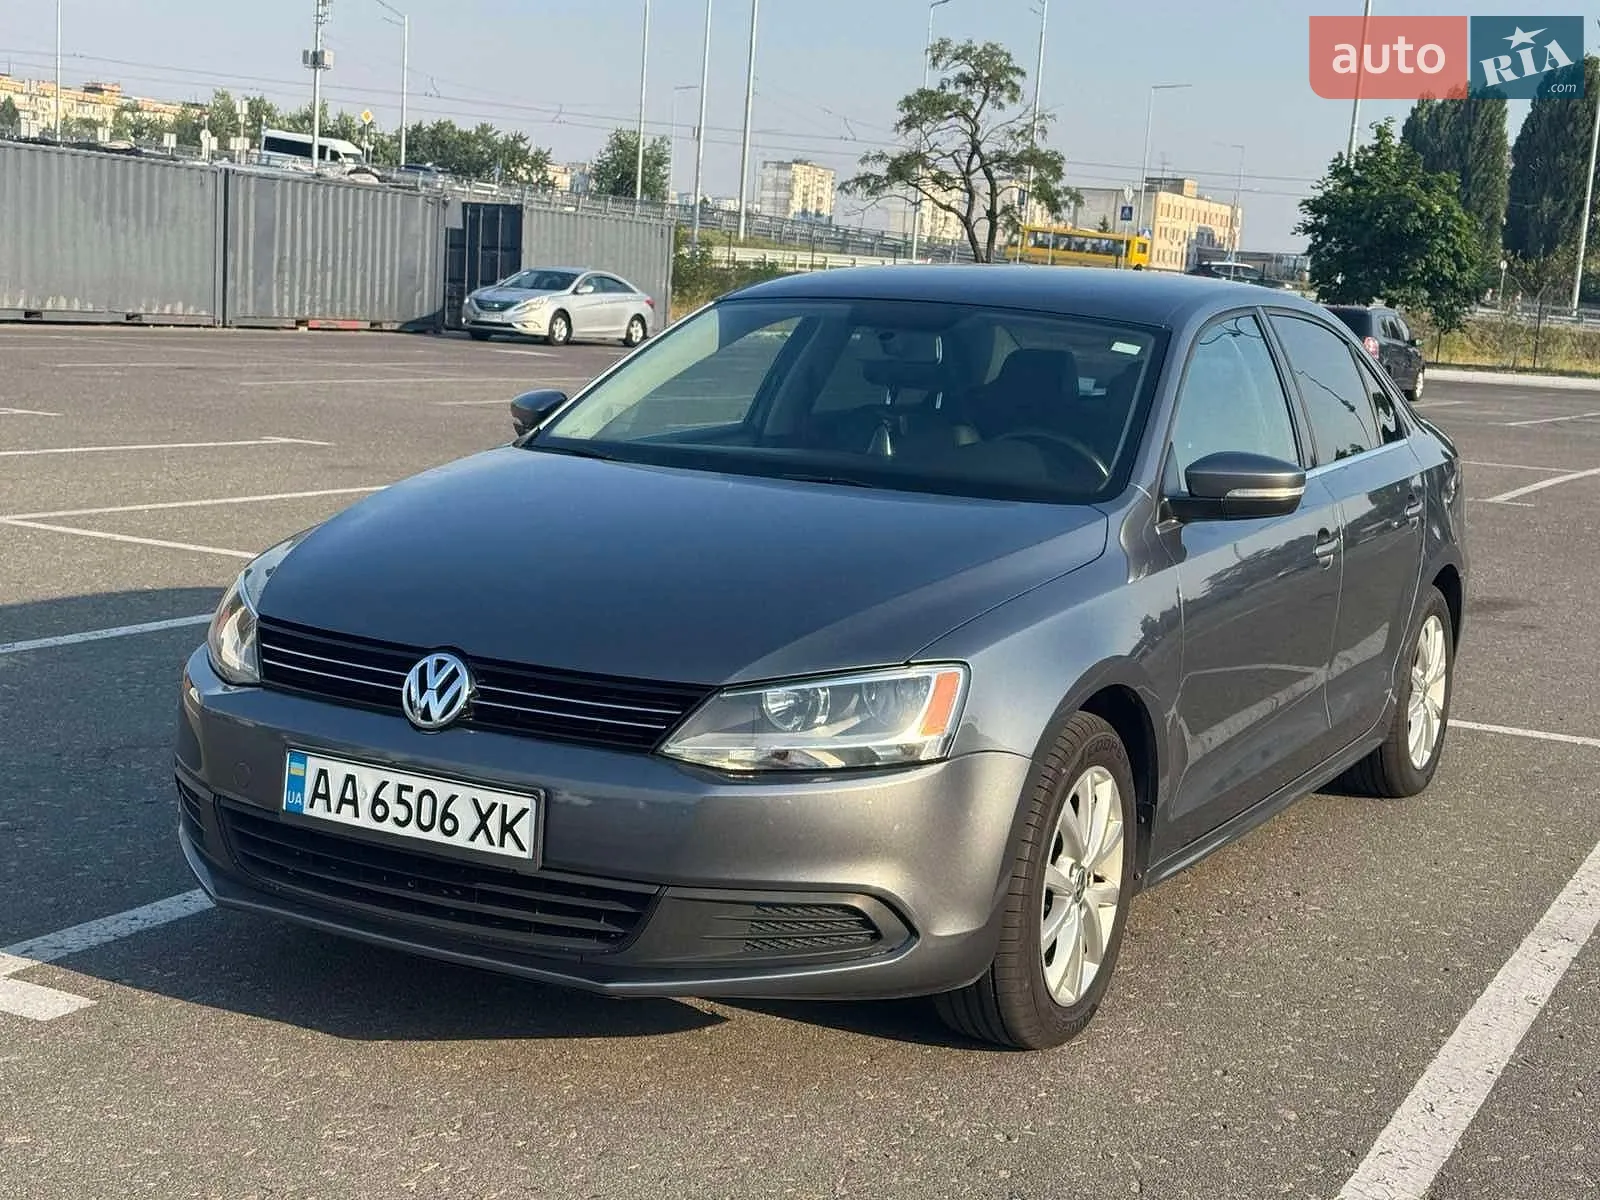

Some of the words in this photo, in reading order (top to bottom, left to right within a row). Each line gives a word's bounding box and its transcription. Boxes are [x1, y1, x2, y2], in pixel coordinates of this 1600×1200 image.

[288, 791, 302, 805] UA
[309, 768, 360, 818] AA
[370, 780, 459, 837] 6506
[468, 797, 530, 852] XK
